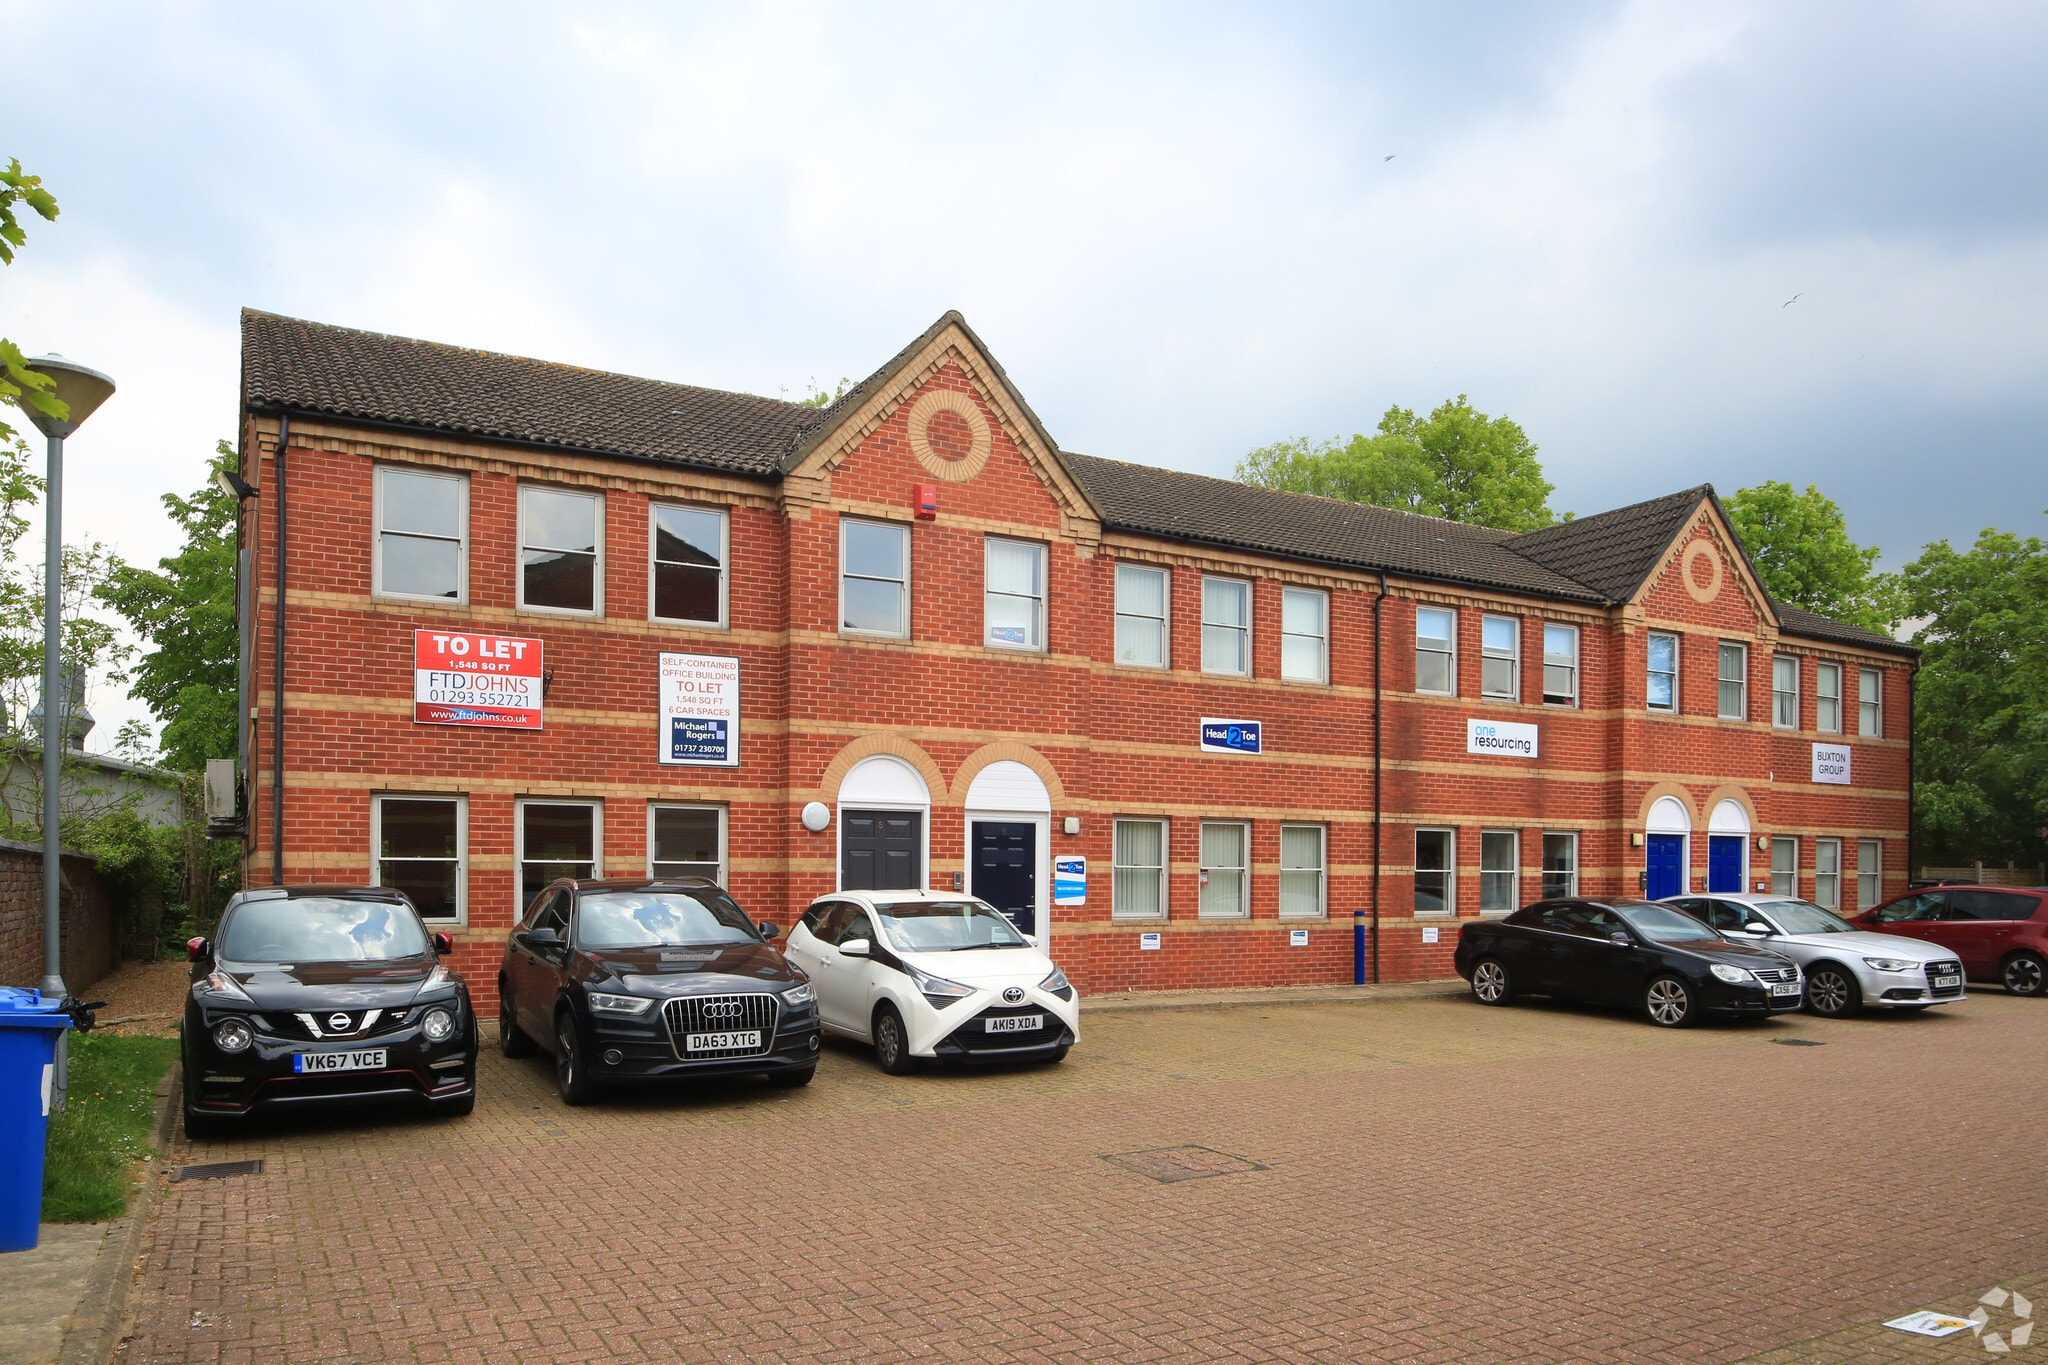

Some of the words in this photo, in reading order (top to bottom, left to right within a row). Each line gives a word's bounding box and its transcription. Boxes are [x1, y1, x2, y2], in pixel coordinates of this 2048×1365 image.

[432, 635, 470, 656] TO
[479, 639, 528, 660] LET
[449, 660, 478, 669] 1,548
[481, 662, 496, 671] SQ
[498, 664, 511, 672] FT
[662, 658, 737, 670] SELF-CONTAINED
[662, 669, 694, 678] OFFICE
[695, 671, 736, 681] BUILDING
[430, 672, 529, 694] FTDJOHNS
[676, 680, 695, 692] TO
[698, 682, 723, 694] LET
[429, 689, 474, 704] 01293
[479, 692, 529, 707] 552721
[699, 696, 711, 705] SQ
[713, 697, 724, 705] FT
[430, 710, 528, 724] www.ftdjohns.co.uk
[668, 706, 674, 714] 6
[675, 706, 694, 715] CAR
[696, 707, 731, 717] SPACES
[674, 721, 707, 731] Michael
[1475, 725, 1496, 737] one
[686, 730, 715, 741] Rogers
[1206, 728, 1227, 739] Head
[1230, 728, 1241, 744] 2
[1241, 730, 1256, 741] Toe
[674, 744, 697, 752] 01737
[698, 745, 725, 753] 230700
[1475, 736, 1531, 754] resourcing
[1817, 751, 1846, 763] BUXTON
[1818, 764, 1845, 775] GROUP
[992, 1019, 1015, 1031] AK19
[1018, 1017, 1037, 1029] XDA
[693, 1035, 728, 1049] DA63
[731, 1033, 756, 1046] XTG
[305, 1053, 348, 1070] VK67
[353, 1052, 383, 1067] VCE
